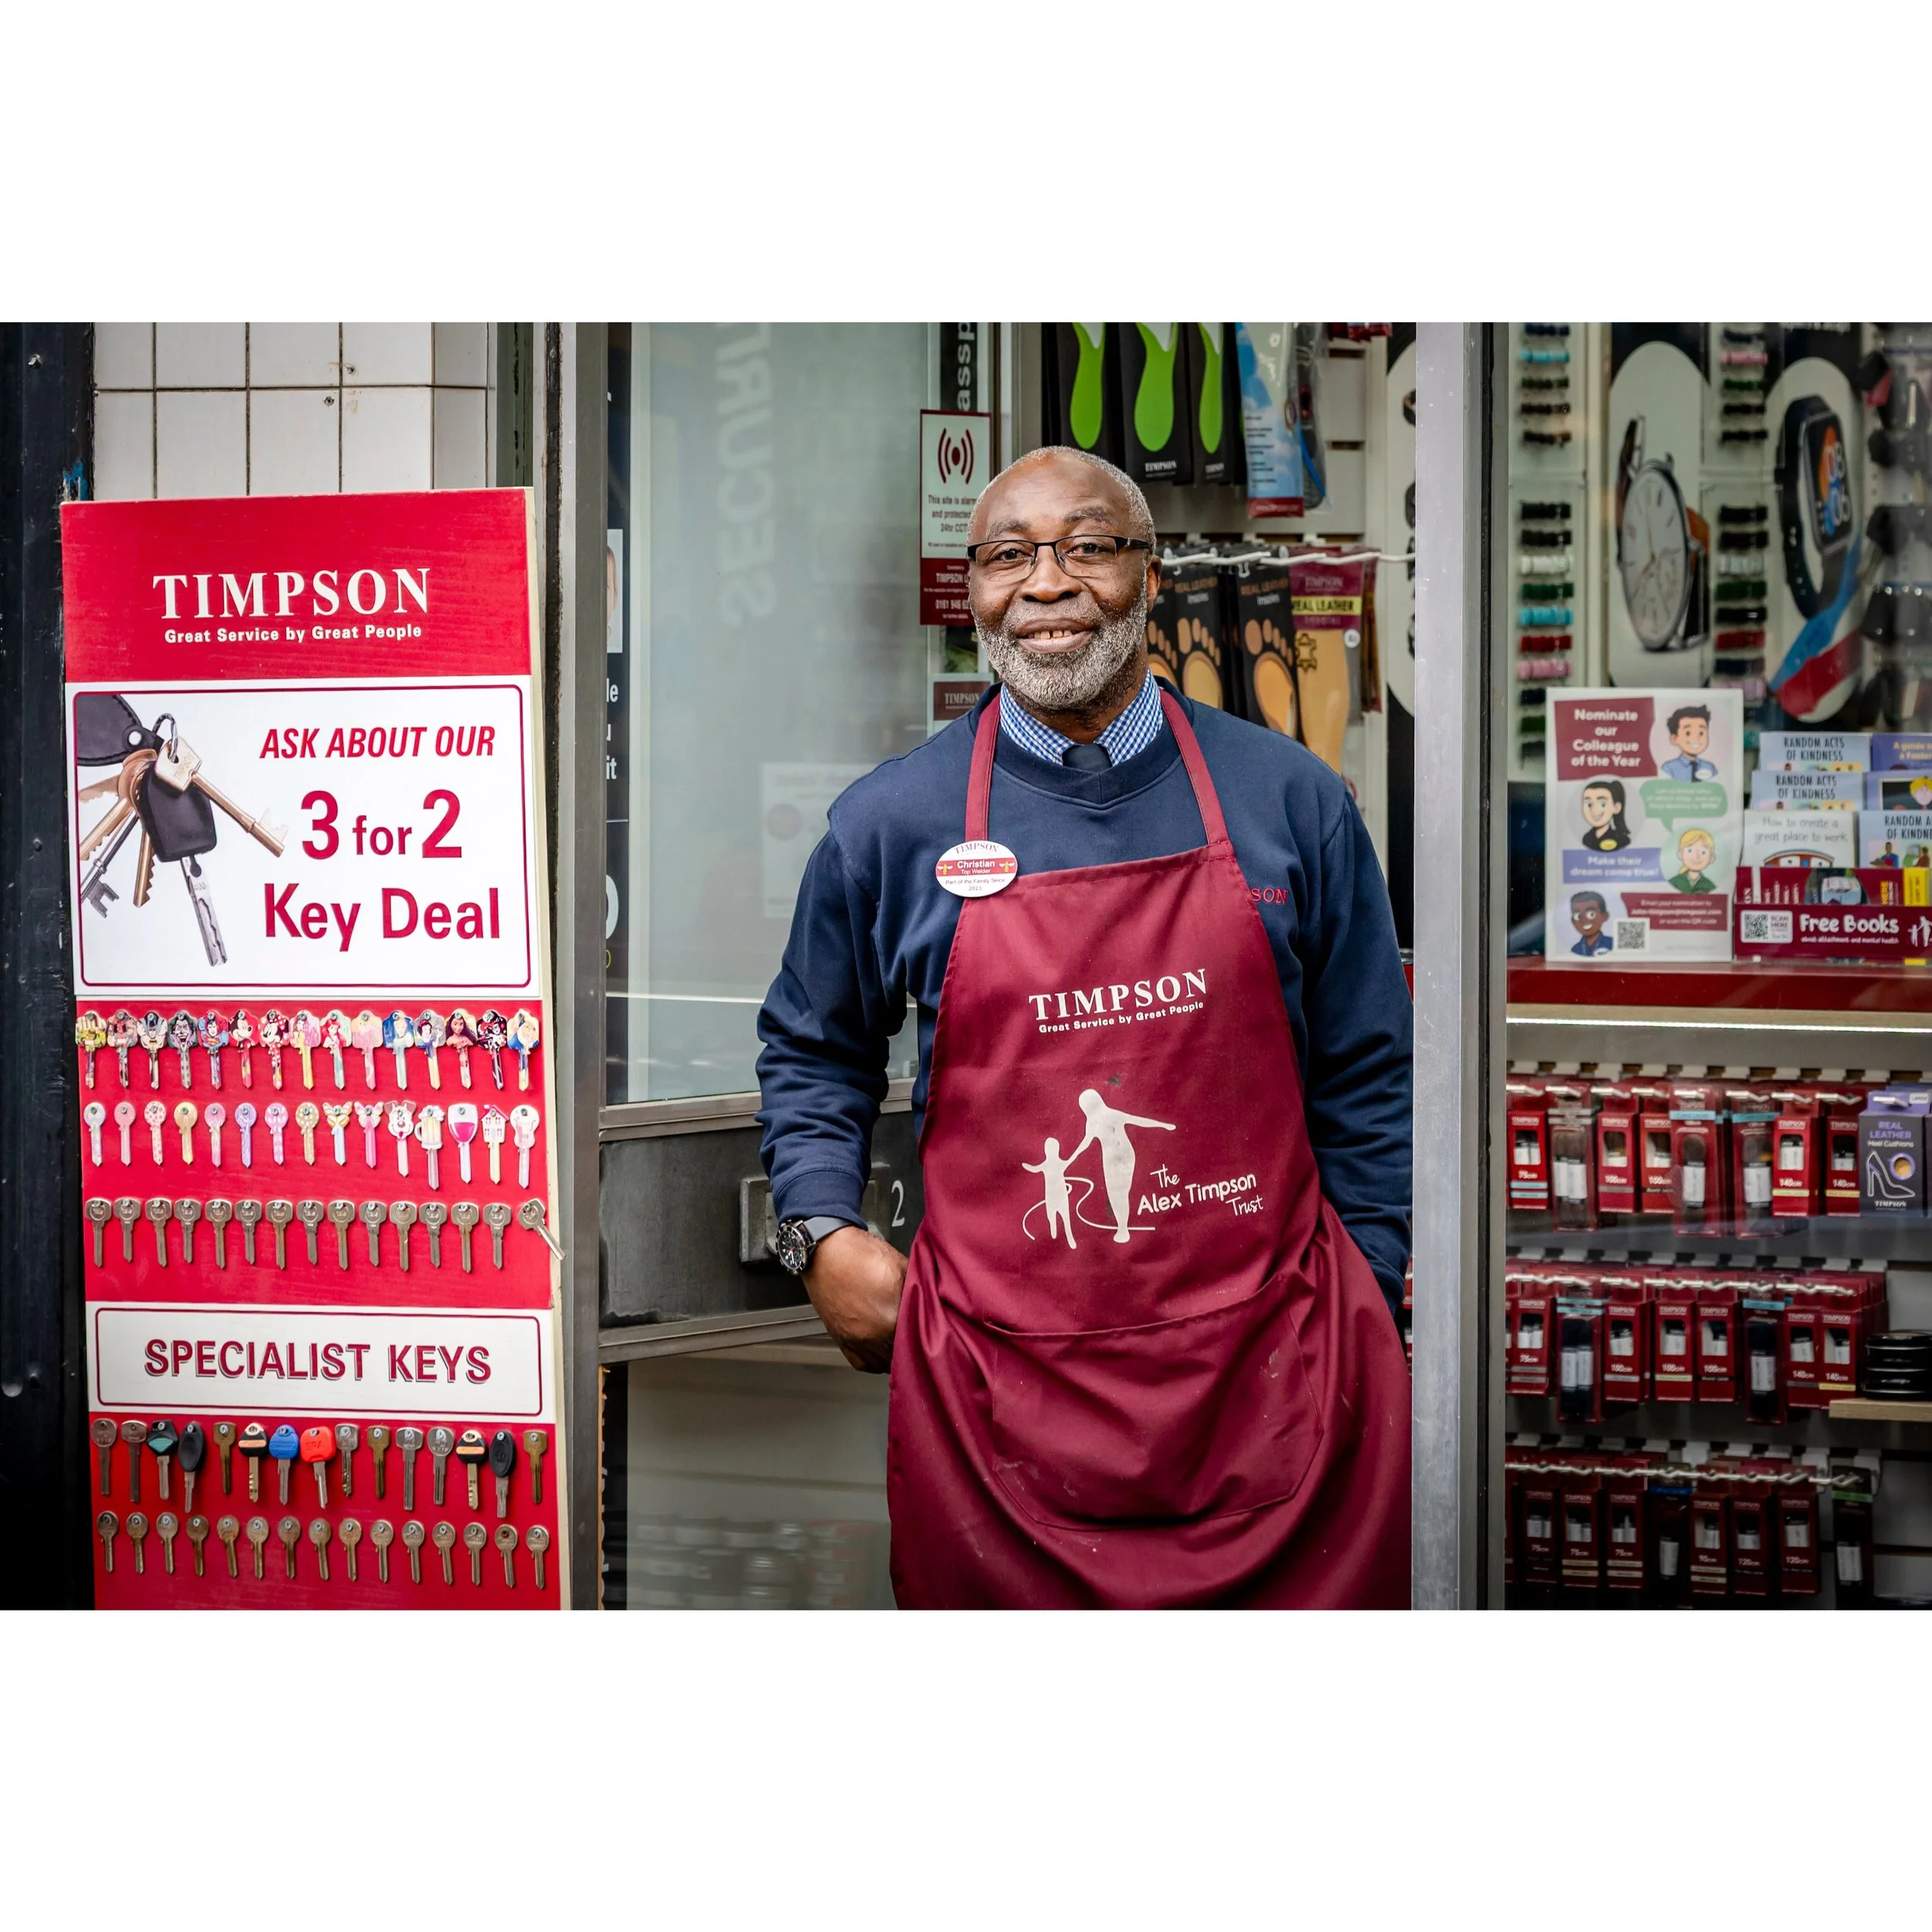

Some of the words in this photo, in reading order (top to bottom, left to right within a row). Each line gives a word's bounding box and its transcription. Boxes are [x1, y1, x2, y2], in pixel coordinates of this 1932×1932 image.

[928, 495, 940, 504] This
[961, 496, 977, 505] alarm
[936, 573, 963, 583] TIMPSON
[153, 568, 430, 619] TIMPSON
[1316, 600, 1354, 612] LEATHER
[165, 629, 211, 643] Great
[217, 627, 279, 642] Service
[285, 627, 305, 643] by
[311, 625, 359, 640] Great
[365, 624, 422, 641] People
[1574, 709, 1638, 721] Nominate
[1594, 726, 1617, 736] our
[260, 728, 320, 758] ASK
[325, 726, 427, 757] ABOUT
[435, 726, 495, 757] OUR
[1572, 739, 1639, 754] Colleague
[1784, 736, 1821, 748] RANDOM
[1825, 736, 1845, 748] ACTS
[1571, 755, 1585, 767] of
[1587, 756, 1610, 767] the
[1611, 755, 1641, 767] Year
[1787, 750, 1796, 761] OF
[1801, 750, 1844, 761] KINDNESS
[1777, 775, 1813, 787] RANDOM
[1817, 775, 1837, 787] ACTS
[1778, 788, 1788, 799] OF
[1793, 788, 1836, 801] KINDNESS
[301, 790, 340, 860] 3
[352, 815, 412, 855] for
[422, 789, 462, 859] 2
[1763, 816, 1783, 827] How
[1787, 817, 1797, 827] to
[1800, 817, 1828, 828] create
[1885, 815, 1922, 827] RANDOM
[1755, 832, 1780, 845] great
[1784, 831, 1808, 843] place
[1812, 832, 1821, 843] to
[1825, 833, 1848, 843] work
[1887, 828, 1896, 840] OF
[955, 842, 999, 854] TIMPSON
[957, 860, 995, 869] Christian
[1588, 856, 1616, 866] Make
[1570, 868, 1603, 876] dream
[264, 883, 361, 952] Key
[382, 887, 500, 940] Deal
[1800, 913, 1839, 933] Free
[1843, 913, 1900, 934] Books
[1029, 968, 1207, 1021] TIMPSON
[1039, 1022, 1070, 1033] Great
[1073, 1017, 1115, 1030] Service
[1118, 1015, 1132, 1025] by
[1136, 1008, 1166, 1022] Great
[1169, 1002, 1204, 1015] People
[1878, 1121, 1903, 1130] REAL
[1870, 1131, 1912, 1140] LEATHER
[1150, 1164, 1180, 1188] The
[1138, 1193, 1182, 1216] Alex
[1185, 1174, 1257, 1204] Timpson
[891, 1180, 906, 1227] 2
[1226, 1195, 1264, 1216] Trust
[145, 1339, 371, 1380] SPECIALIST
[387, 1344, 492, 1384] KEYS
